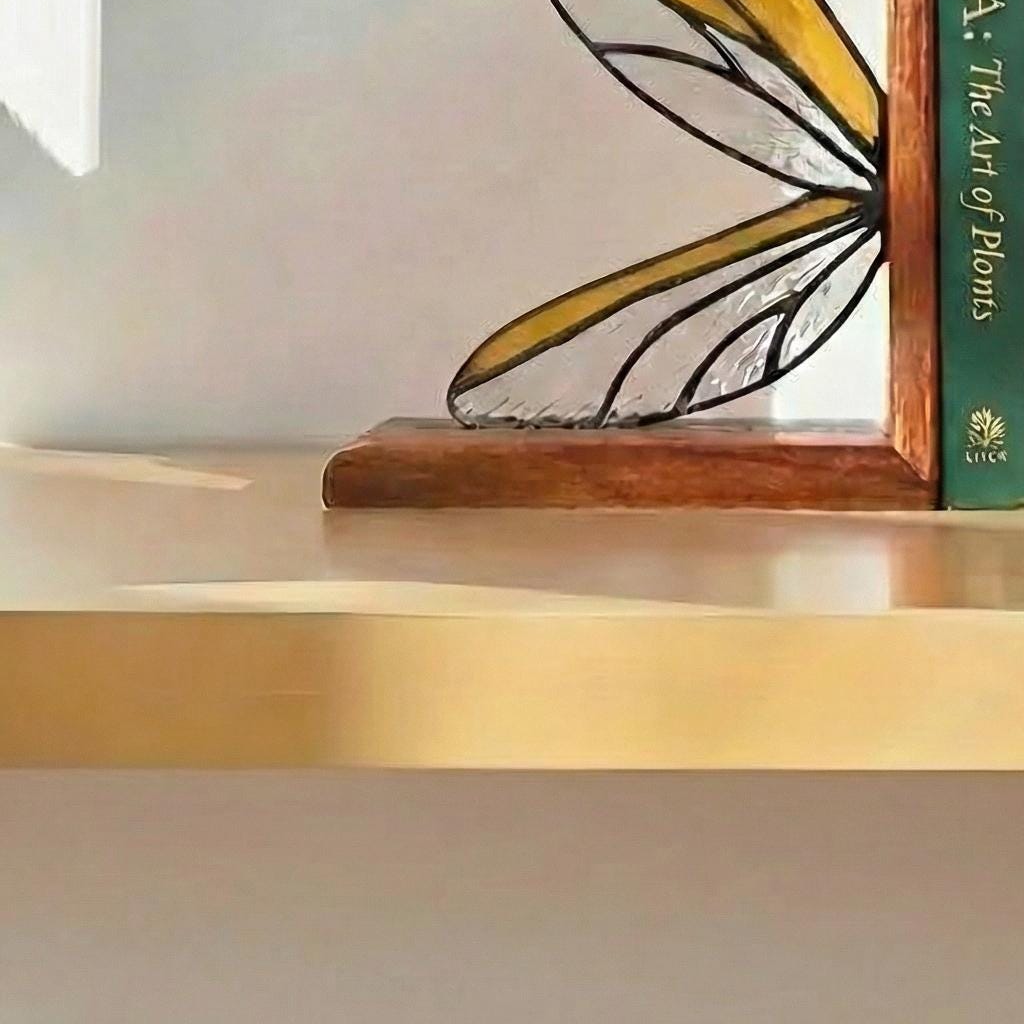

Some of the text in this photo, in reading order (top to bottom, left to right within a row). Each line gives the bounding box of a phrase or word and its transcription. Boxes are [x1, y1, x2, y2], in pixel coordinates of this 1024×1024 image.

[967, 58, 1005, 117] The
[969, 123, 1001, 177] Art
[960, 186, 1005, 224] of
